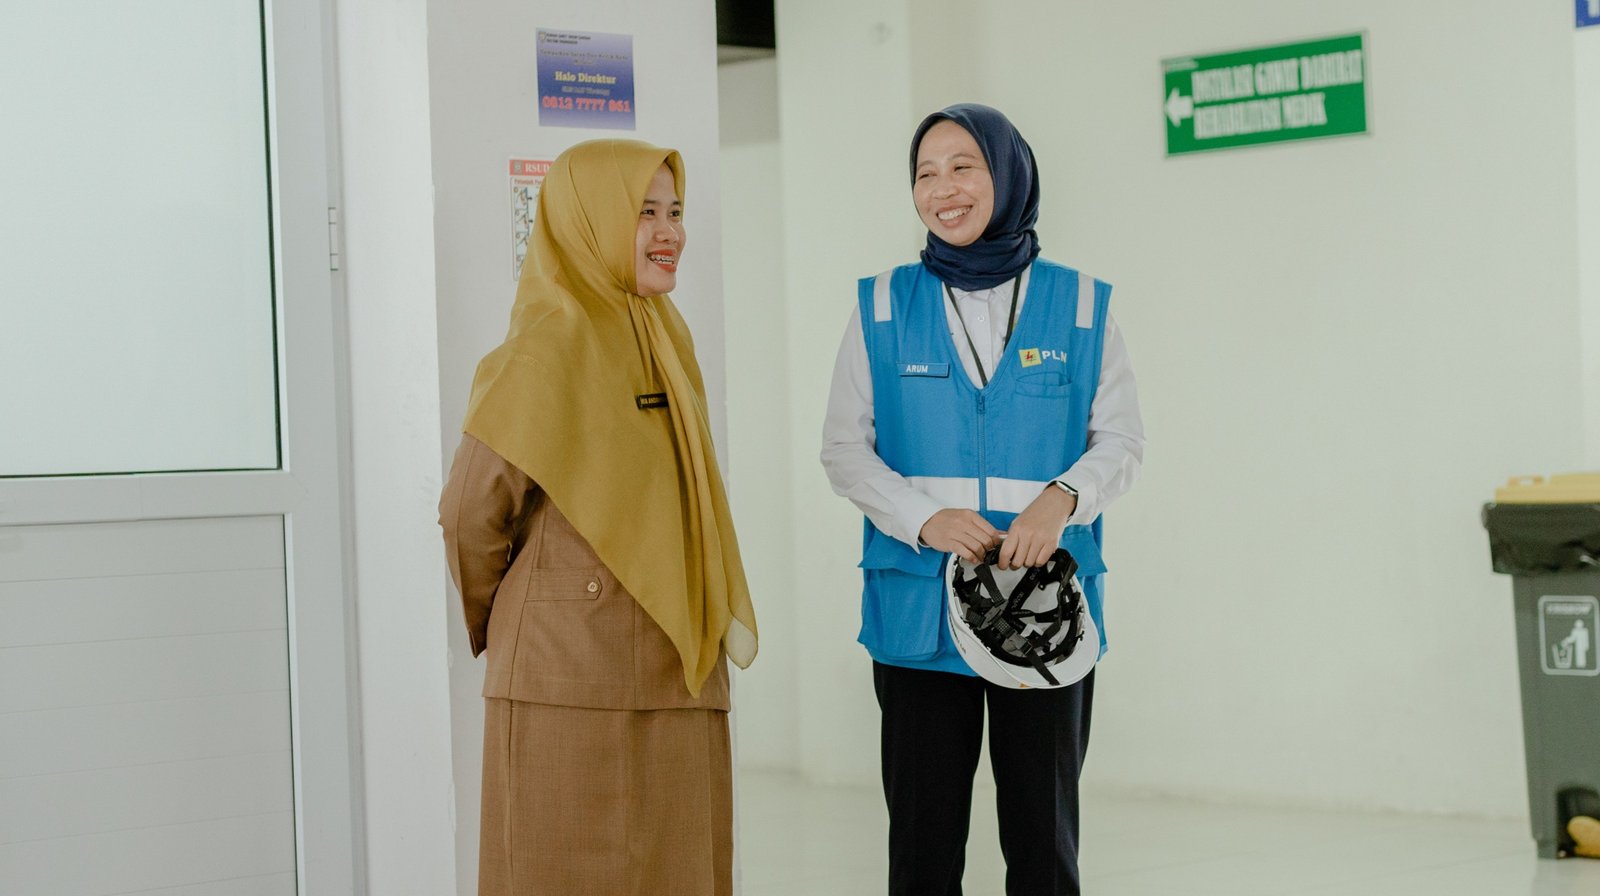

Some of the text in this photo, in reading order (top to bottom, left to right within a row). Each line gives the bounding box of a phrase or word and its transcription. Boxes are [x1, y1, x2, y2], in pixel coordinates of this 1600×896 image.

[555, 71, 616, 84] Halo Direktur
[1042, 349, 1067, 364] PLN
[905, 364, 929, 374] ARUM
